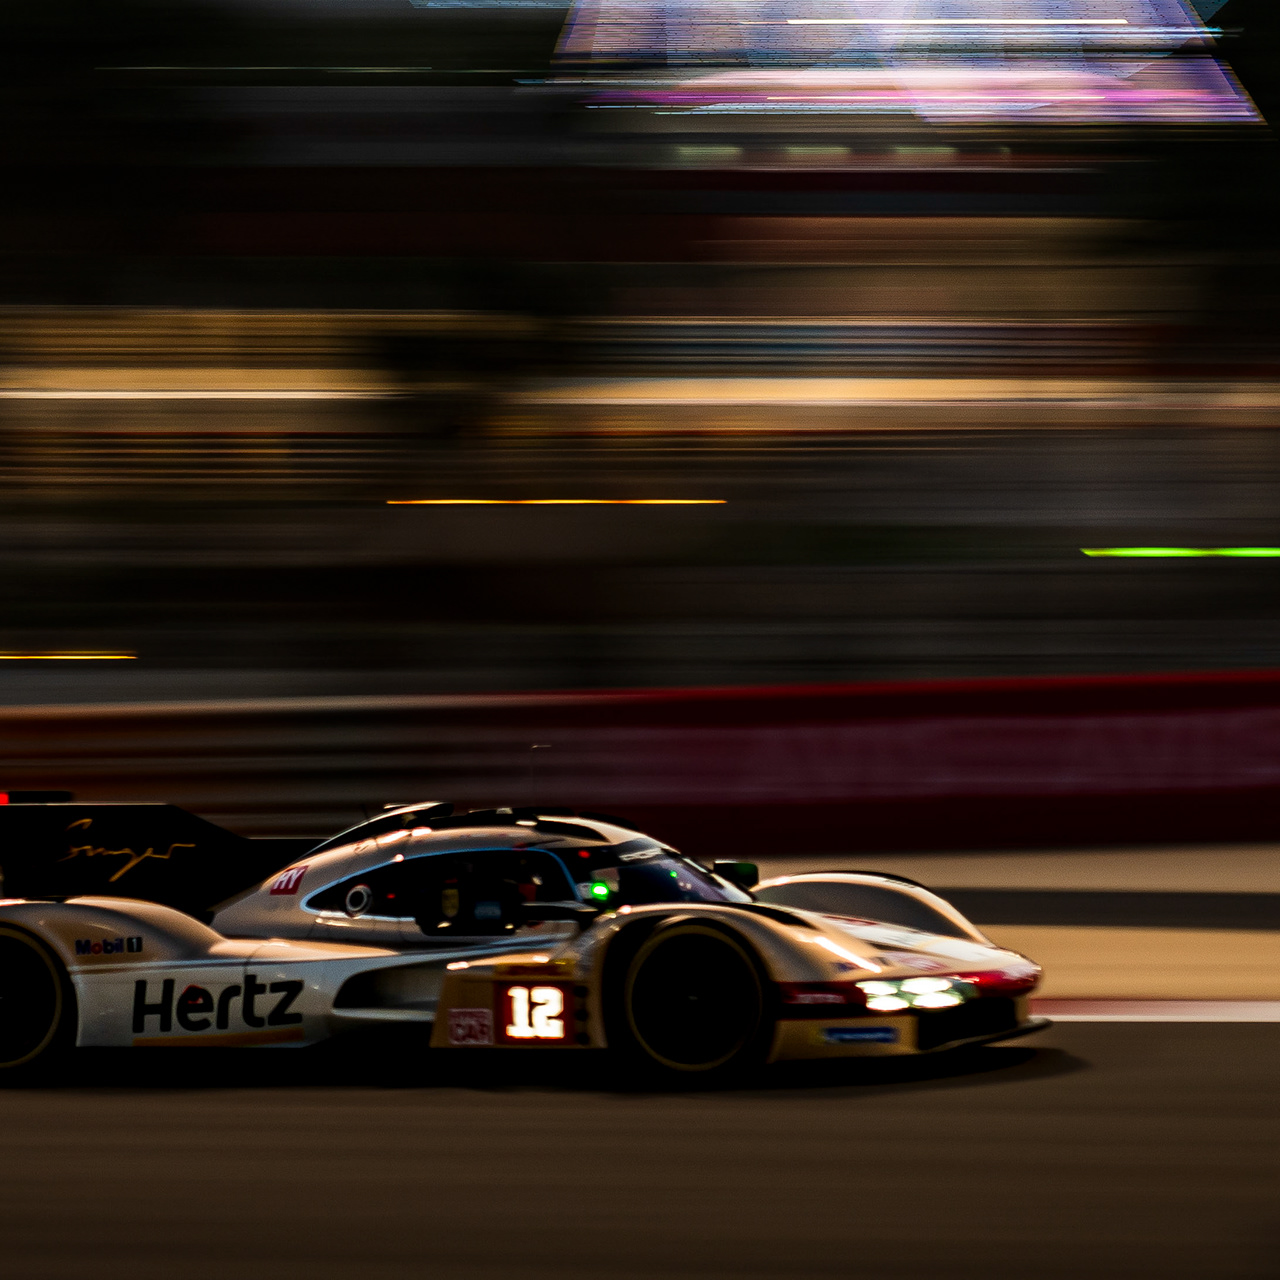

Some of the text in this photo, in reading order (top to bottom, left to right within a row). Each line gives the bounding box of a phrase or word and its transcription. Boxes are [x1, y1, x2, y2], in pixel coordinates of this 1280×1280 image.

[76, 938, 124, 955] Mobil
[132, 974, 304, 1033] Hertz
[506, 985, 565, 1039] 12
